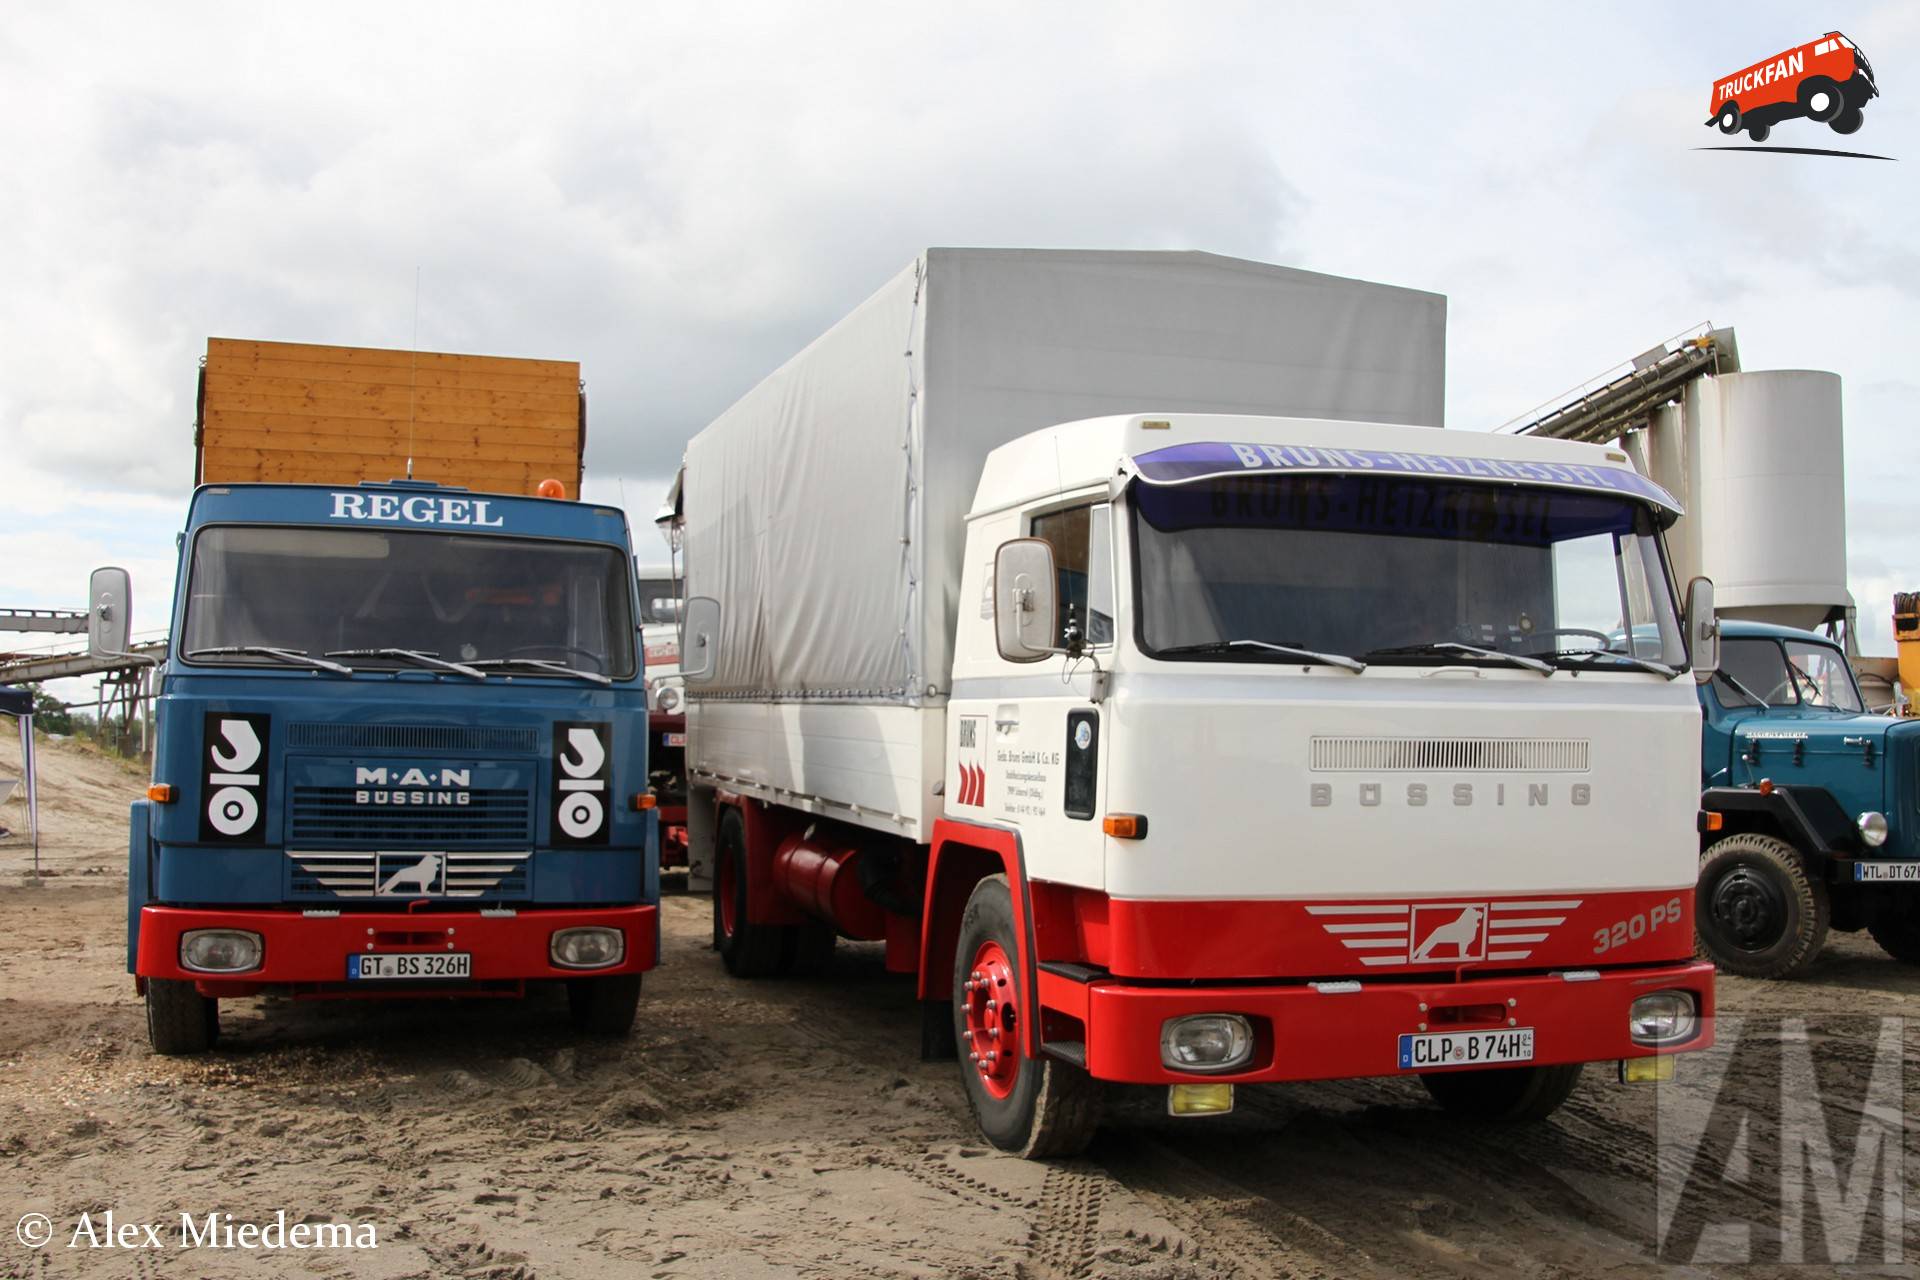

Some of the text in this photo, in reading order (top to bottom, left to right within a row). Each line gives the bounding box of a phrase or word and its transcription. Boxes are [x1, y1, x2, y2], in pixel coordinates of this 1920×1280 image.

[330, 492, 503, 527] REGEL
[1889, 865, 1902, 879] DT
[1593, 897, 1682, 955] 320 PS
[361, 957, 467, 975] GT BS 326H
[1415, 1034, 1521, 1063] CLP B 74H
